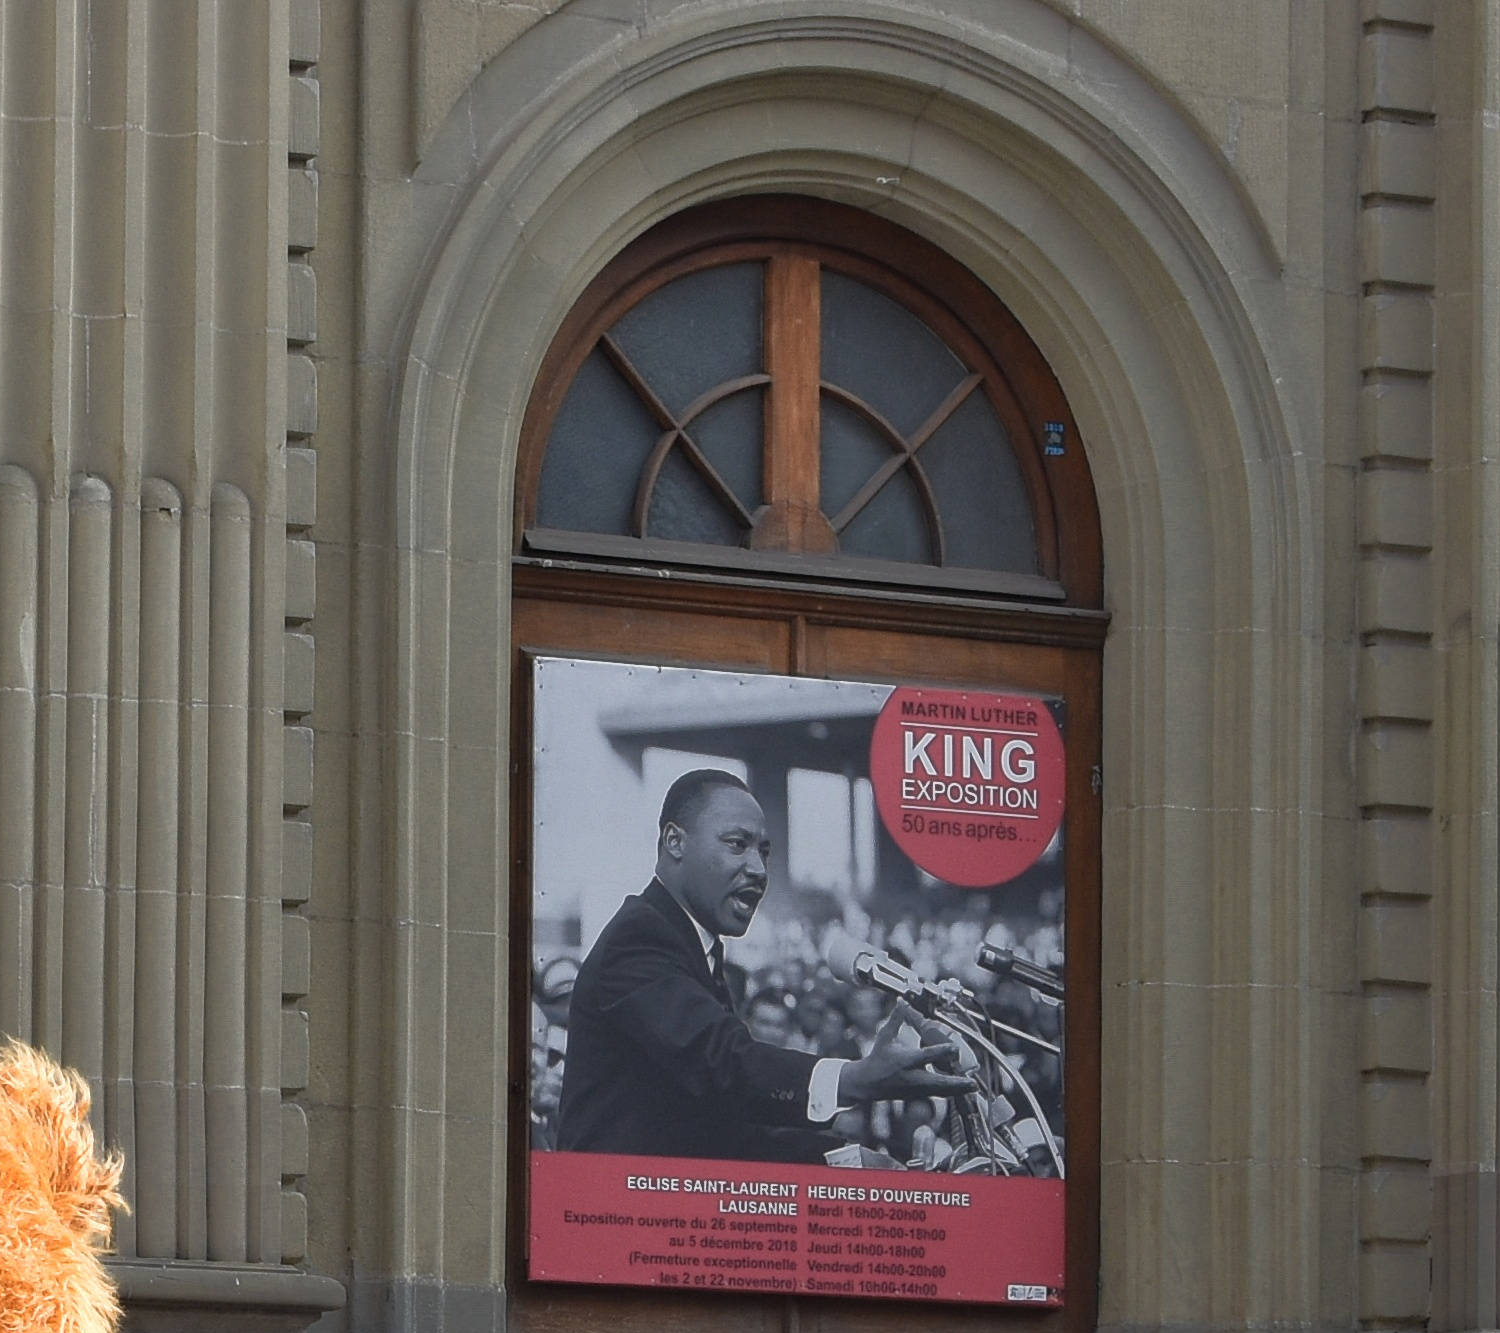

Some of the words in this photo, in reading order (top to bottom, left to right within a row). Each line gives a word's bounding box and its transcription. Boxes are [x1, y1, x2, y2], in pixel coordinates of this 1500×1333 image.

[902, 701, 966, 720] MARTIN
[971, 707, 1038, 726] LUTHER
[904, 731, 1035, 783] KING
[902, 779, 1037, 809] EXPOSITION
[901, 813, 925, 834] 50
[928, 818, 963, 837] ans
[627, 1176, 680, 1191] EGLISE
[683, 1178, 799, 1198] SAINT-LAURENT
[807, 1185, 866, 1201] HEURES
[870, 1188, 972, 1207] D'OUVERTURE
[719, 1199, 798, 1216] LAUSANNE
[807, 1204, 843, 1218] Mardi
[563, 1209, 634, 1227] Exposition
[637, 1216, 687, 1229] ouverte
[690, 1217, 707, 1229] du
[711, 1218, 727, 1231] 26
[729, 1220, 798, 1235] septembre
[807, 1222, 863, 1237] Mercredi
[669, 1236, 685, 1247] au
[689, 1235, 697, 1248] 5
[700, 1236, 764, 1252] décembre
[768, 1239, 798, 1253] 2018
[807, 1241, 842, 1255] Jeudi
[629, 1250, 700, 1267] (Fermeture
[703, 1255, 798, 1271] exceptionnelle
[807, 1260, 864, 1274] Vendredi
[660, 1271, 679, 1285] les
[682, 1272, 690, 1285] 2
[694, 1273, 707, 1286] et
[728, 1276, 798, 1292] novembre)
[806, 1277, 854, 1291] Samedi
